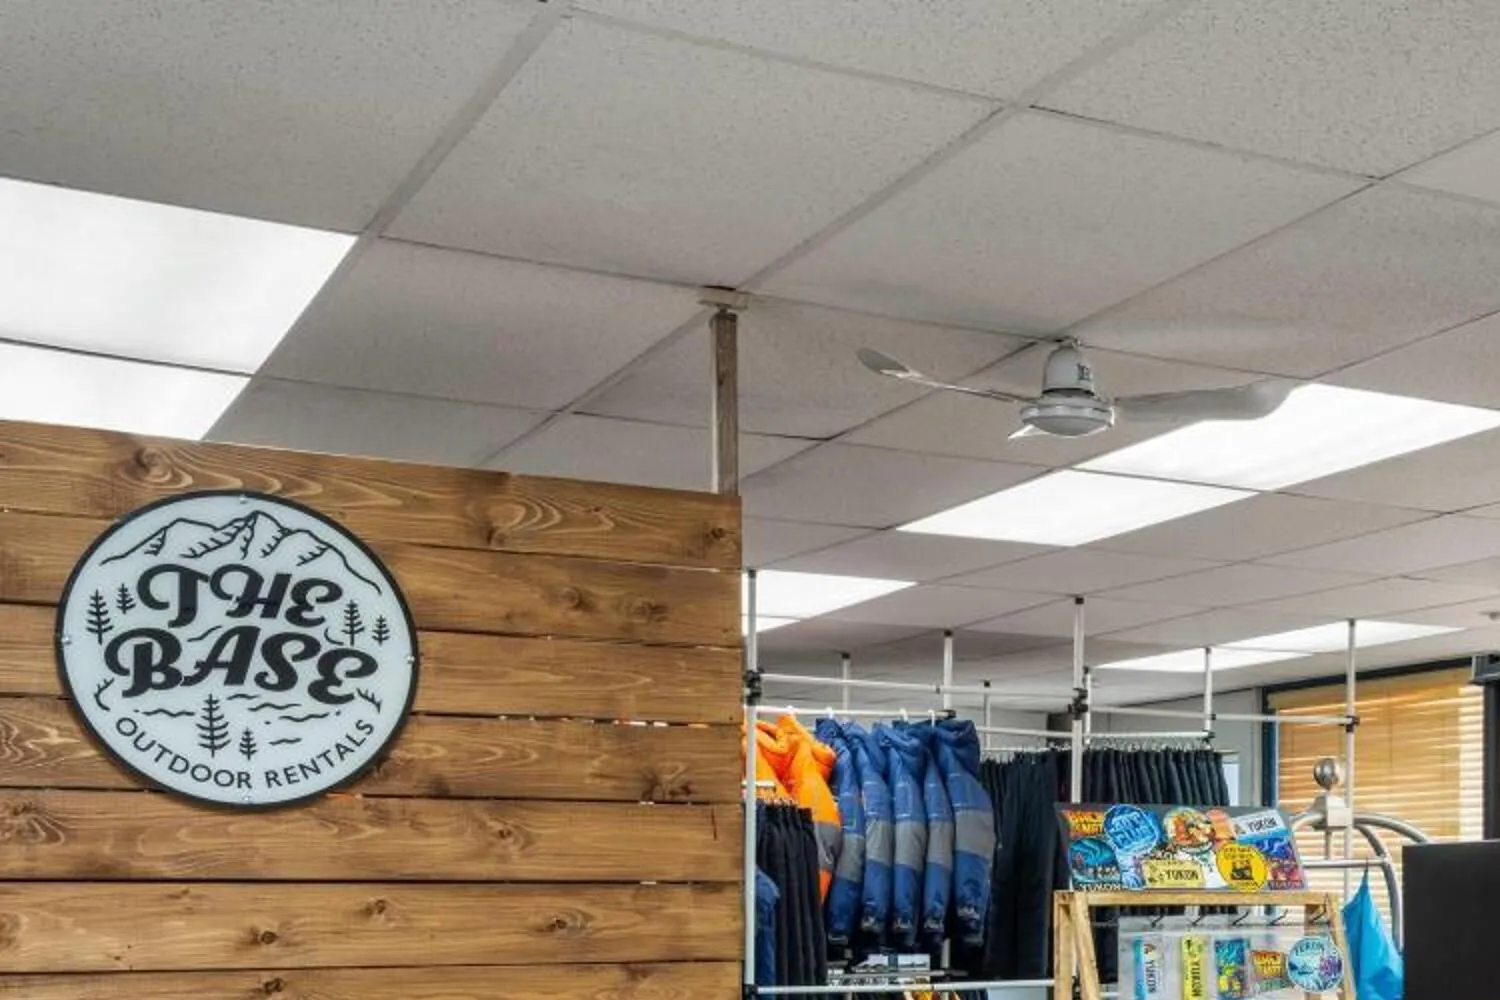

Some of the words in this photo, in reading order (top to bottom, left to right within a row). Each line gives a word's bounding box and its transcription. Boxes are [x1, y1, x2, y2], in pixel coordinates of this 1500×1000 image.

[137, 563, 343, 629] THE
[103, 625, 379, 705] BASE
[116, 716, 253, 789] OUTDOOR
[265, 719, 375, 789] RENTALS
[1164, 869, 1200, 881] YUKON
